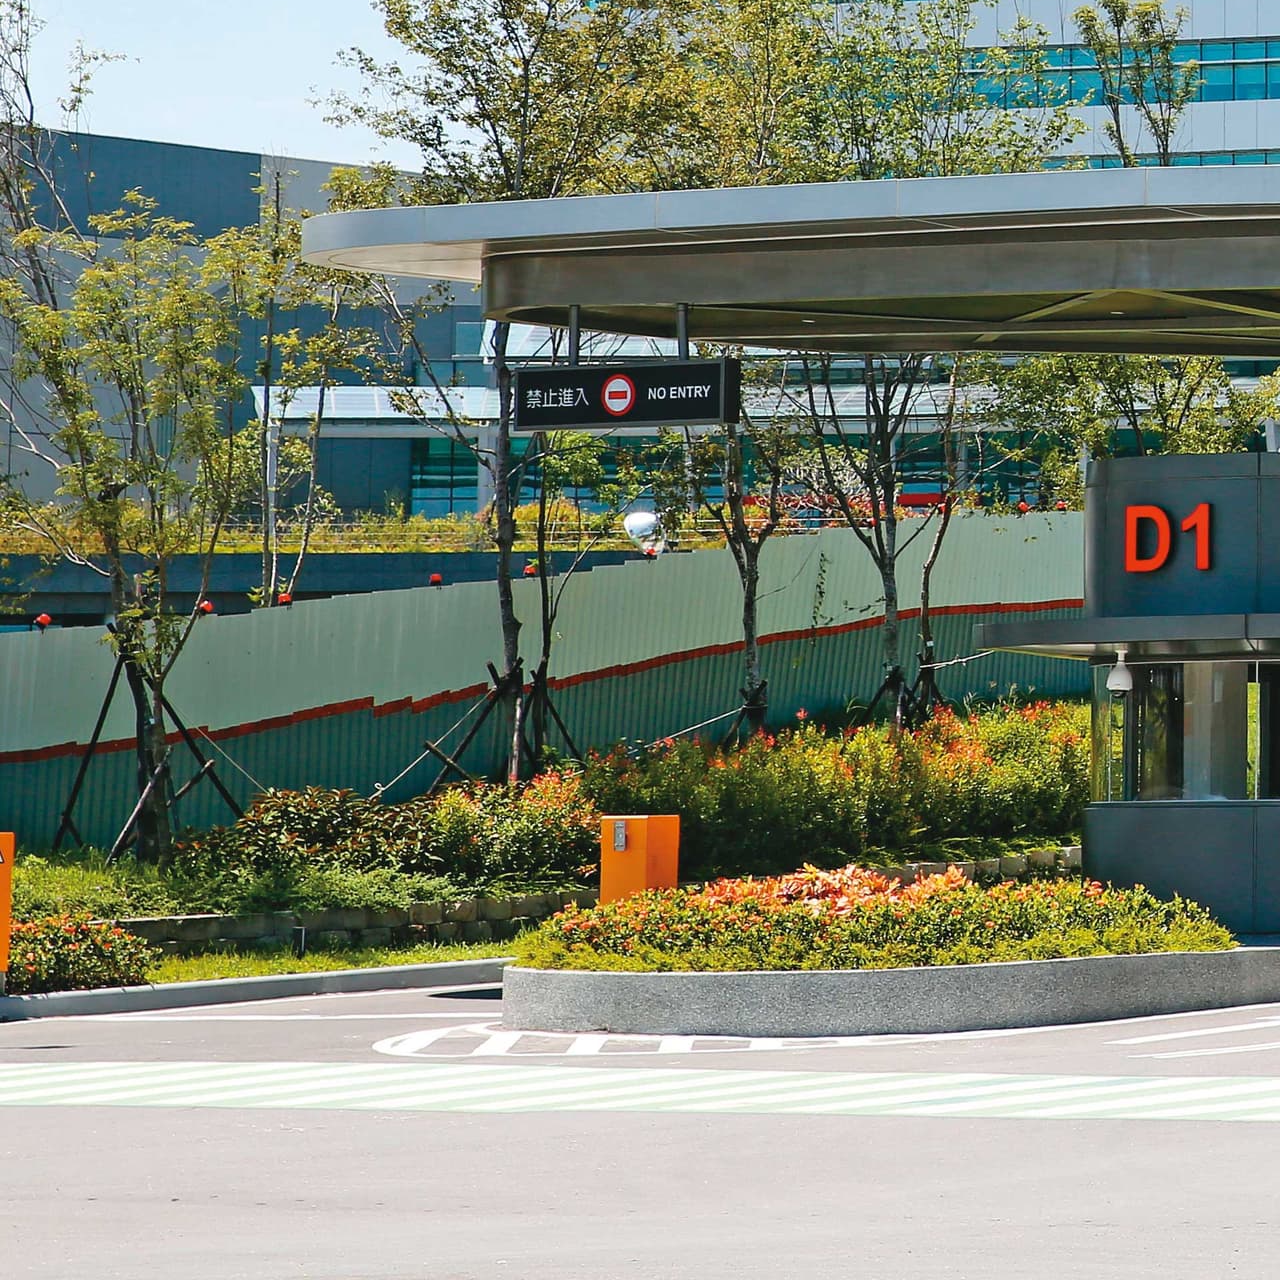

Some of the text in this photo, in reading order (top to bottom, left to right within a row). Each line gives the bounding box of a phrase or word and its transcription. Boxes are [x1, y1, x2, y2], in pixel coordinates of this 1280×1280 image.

[526, 387, 589, 409] 禁止進入
[648, 385, 711, 400] NO ENTRY
[1125, 502, 1210, 573] D1
